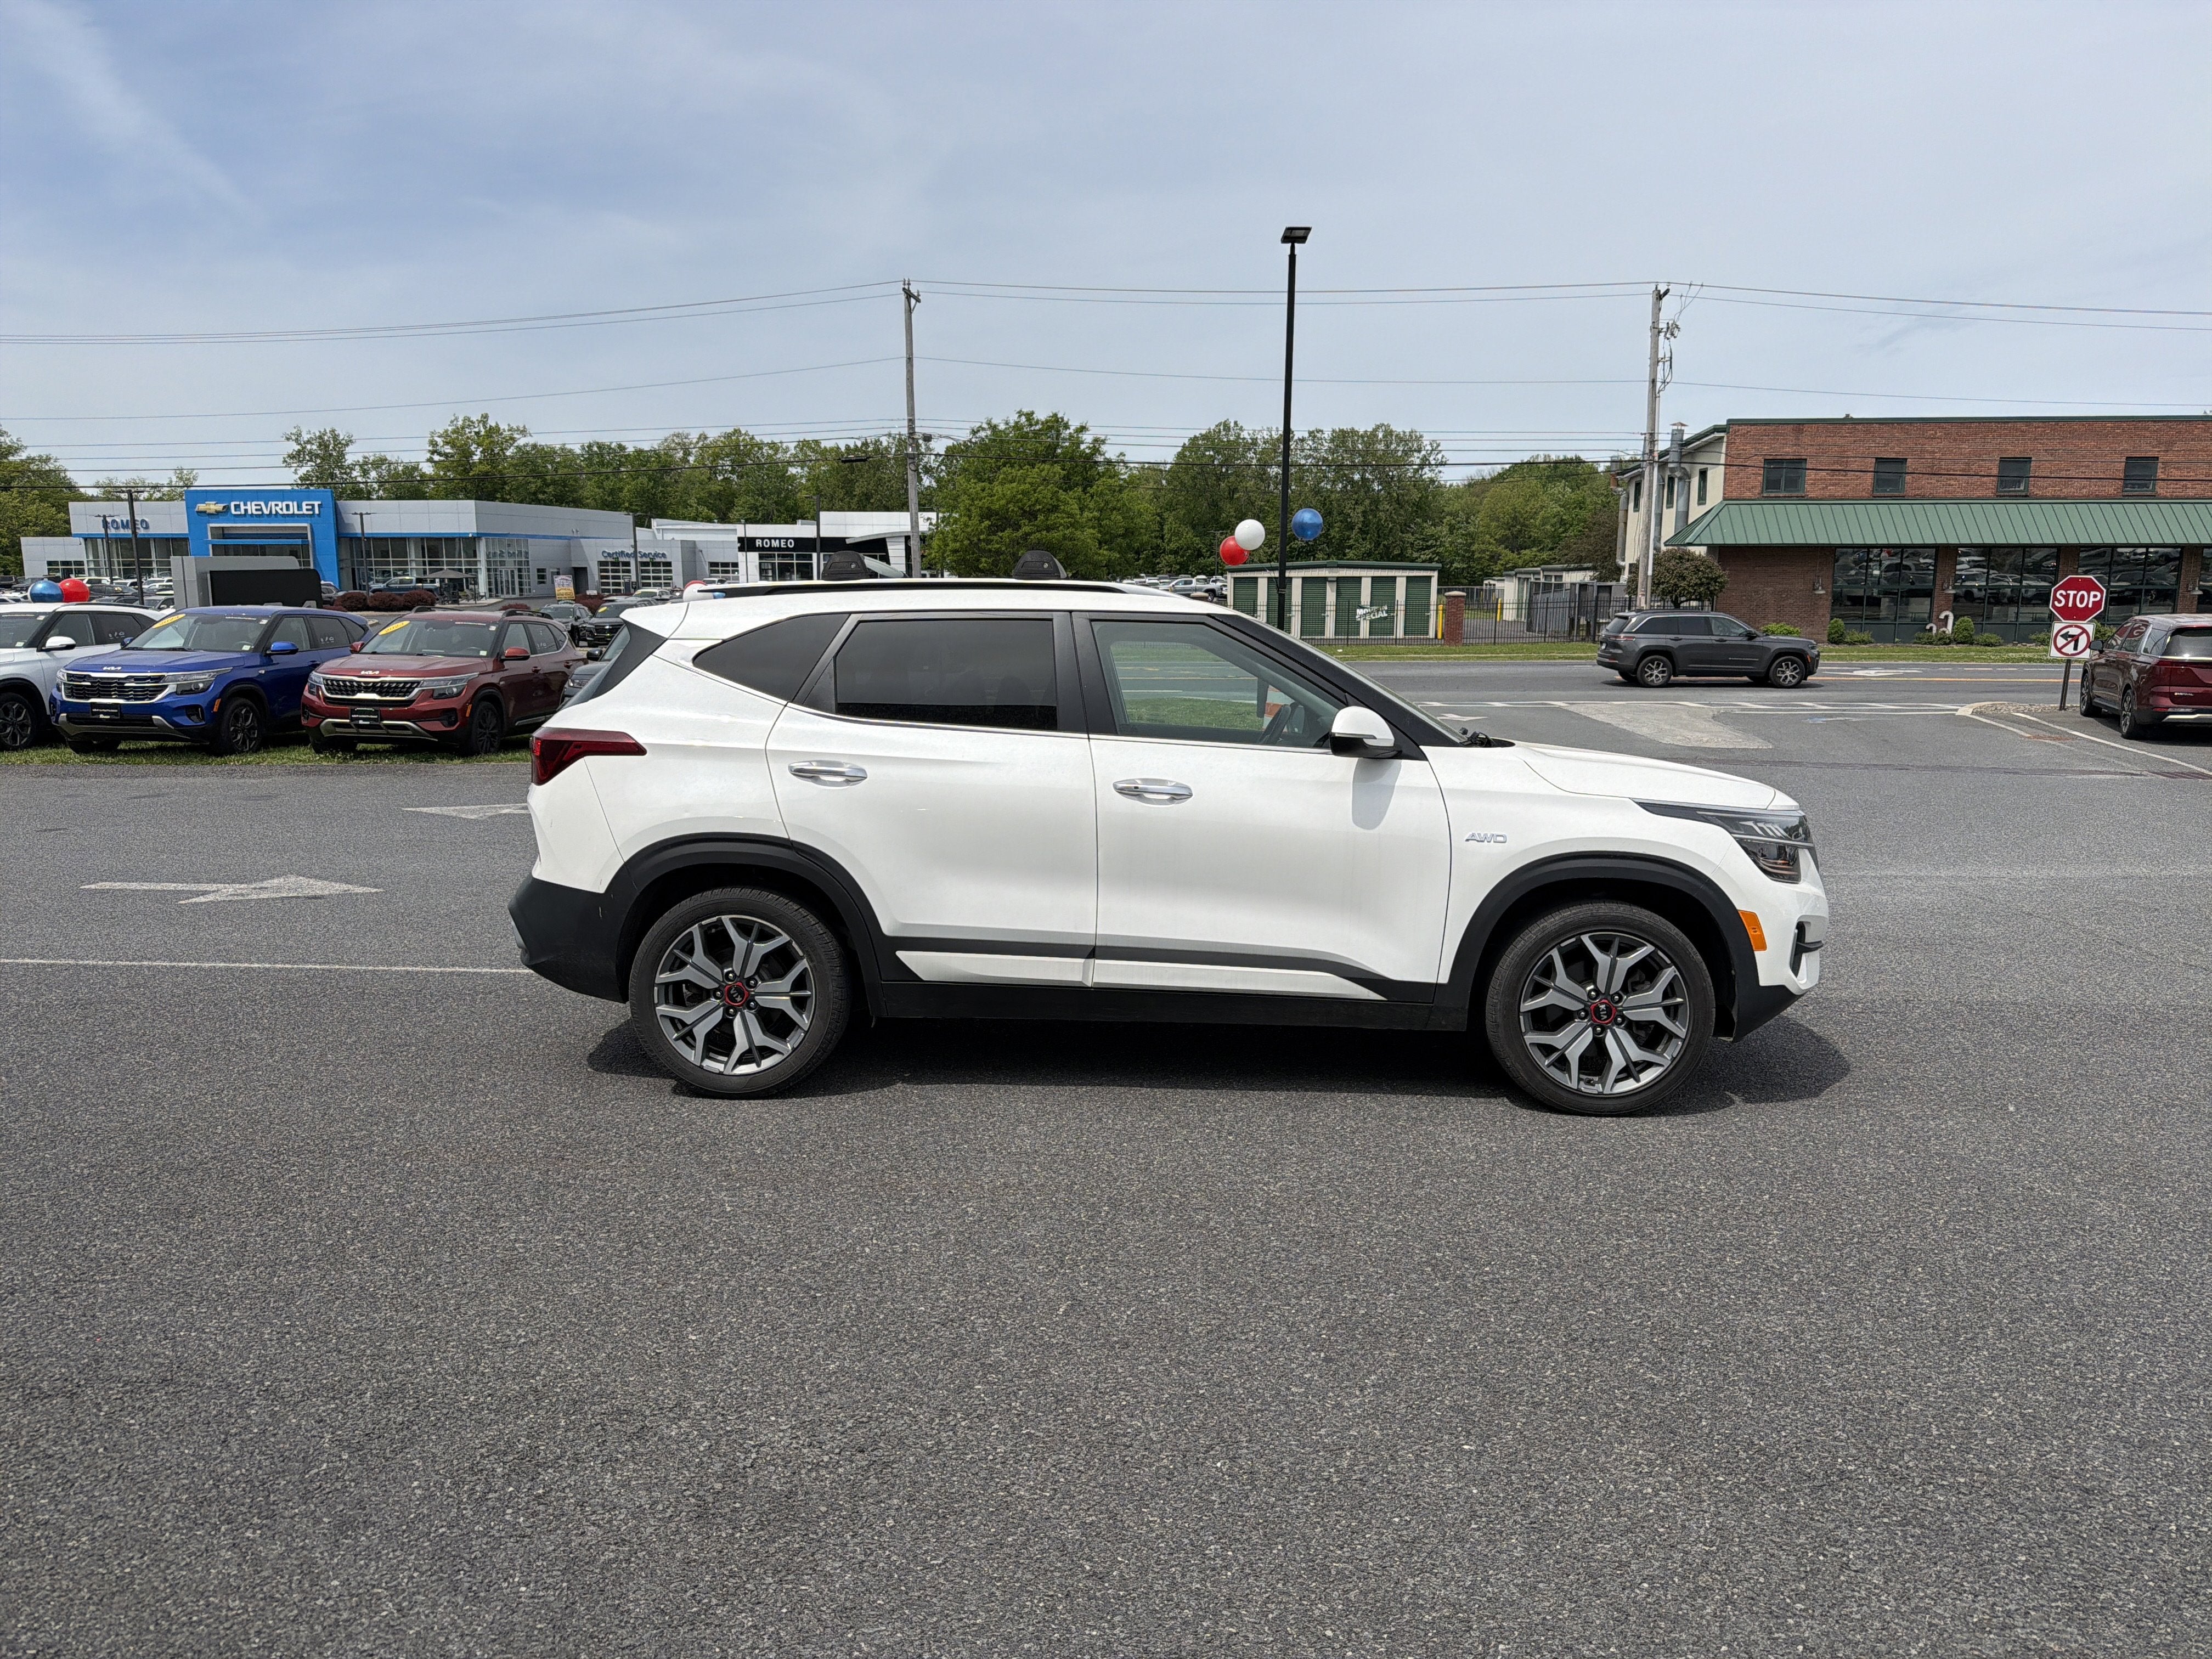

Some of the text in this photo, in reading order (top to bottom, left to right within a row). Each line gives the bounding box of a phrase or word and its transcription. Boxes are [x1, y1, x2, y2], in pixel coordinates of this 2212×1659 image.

[230, 501, 321, 515] CHEVROLET
[755, 539, 794, 548] ROMEO
[601, 550, 667, 558] Certified Service
[2054, 590, 2101, 608] STOP
[1355, 610, 1388, 621] SPECIAL
[1465, 833, 1507, 843] AWD
[1599, 1004, 1607, 1020] KIA
